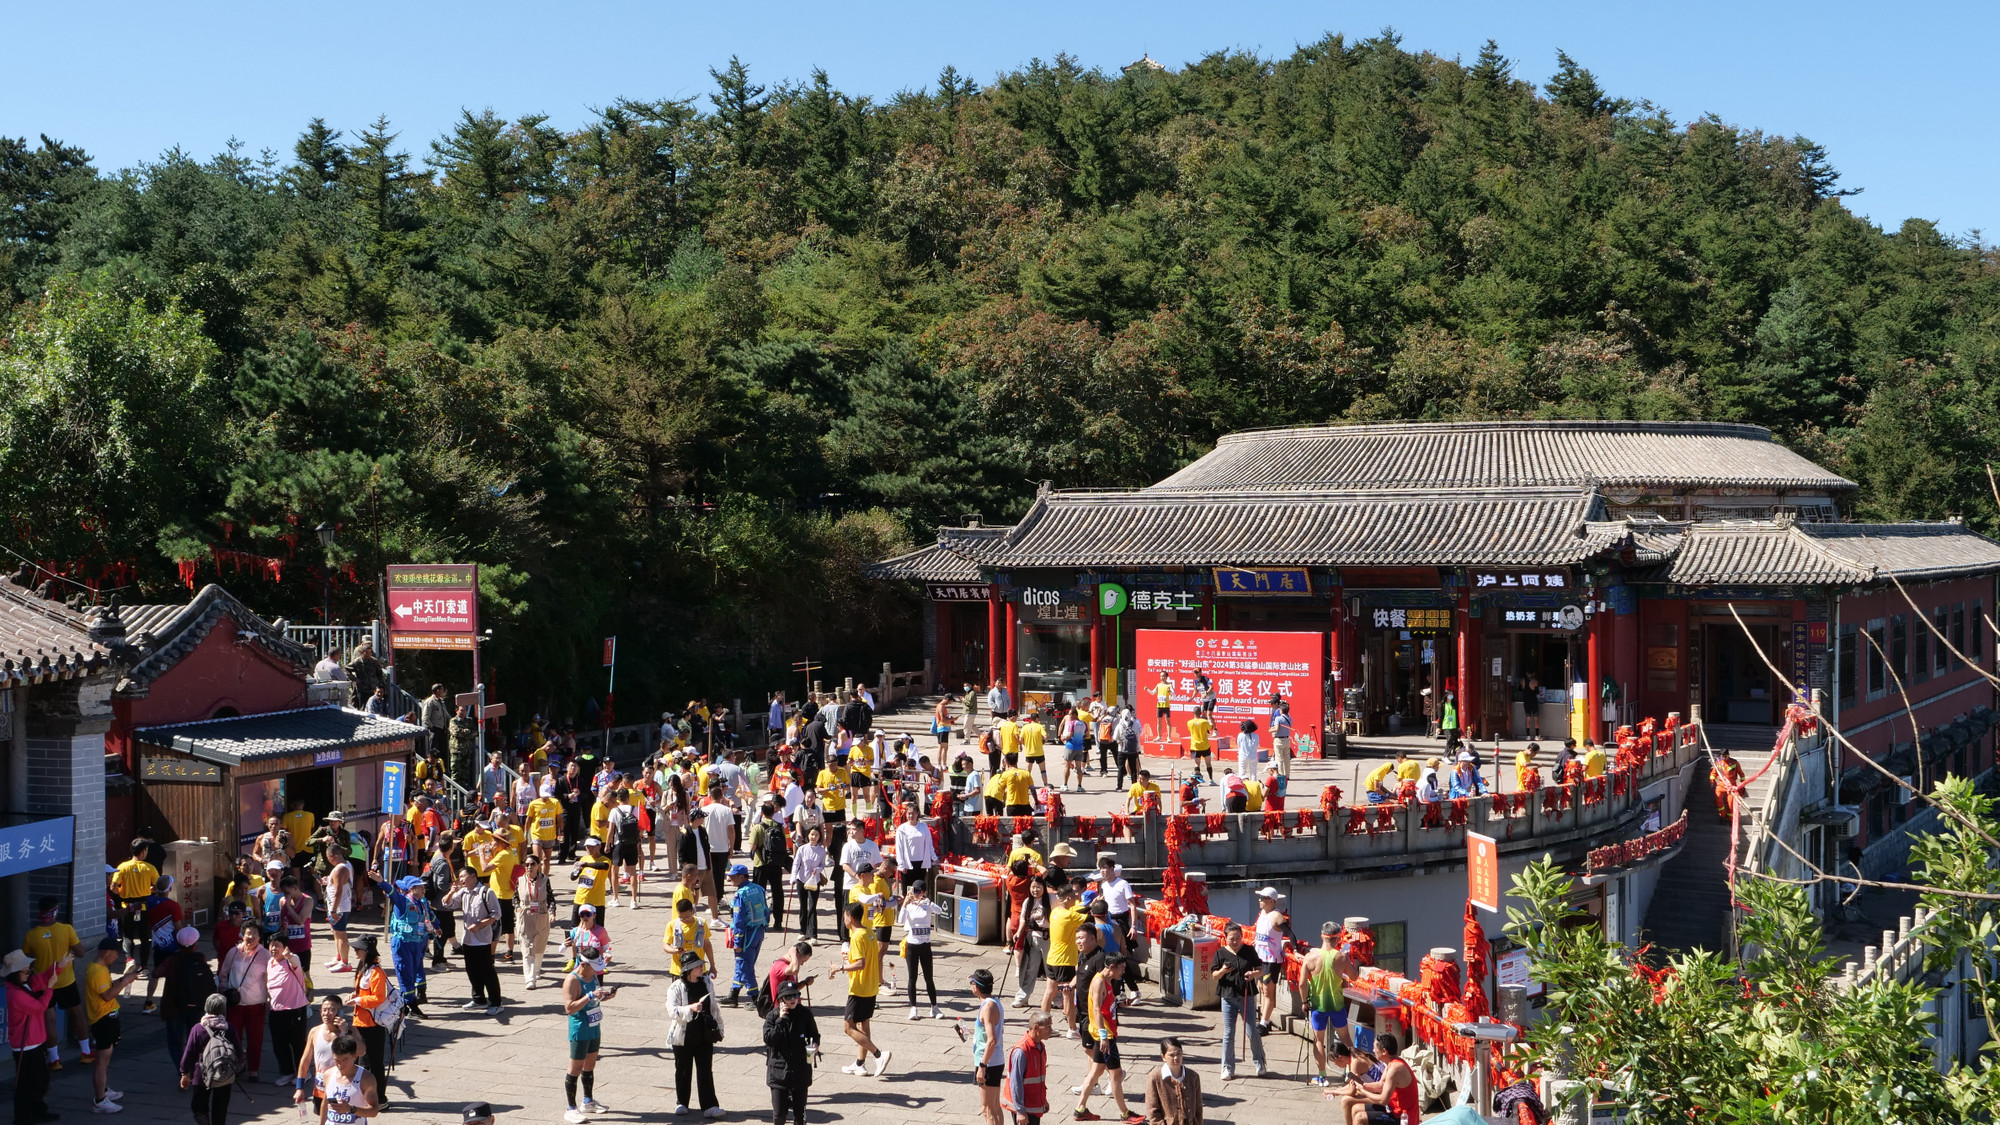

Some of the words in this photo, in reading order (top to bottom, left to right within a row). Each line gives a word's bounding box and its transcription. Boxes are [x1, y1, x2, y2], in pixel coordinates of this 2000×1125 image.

[1476, 574, 1565, 587] 沪上阿姨
[1023, 587, 1060, 606] dicos
[1131, 590, 1195, 611] 德克士
[413, 599, 468, 614] 中天门索道
[1037, 605, 1079, 620] 煌上煌
[1373, 608, 1406, 628] 快餐
[1505, 611, 1536, 621] 热奶茶
[1811, 628, 1826, 637] 119
[0, 834, 56, 862] 服务处
[1200, 946, 1209, 981] 严禁烟火
[329, 1112, 353, 1123] 2099
